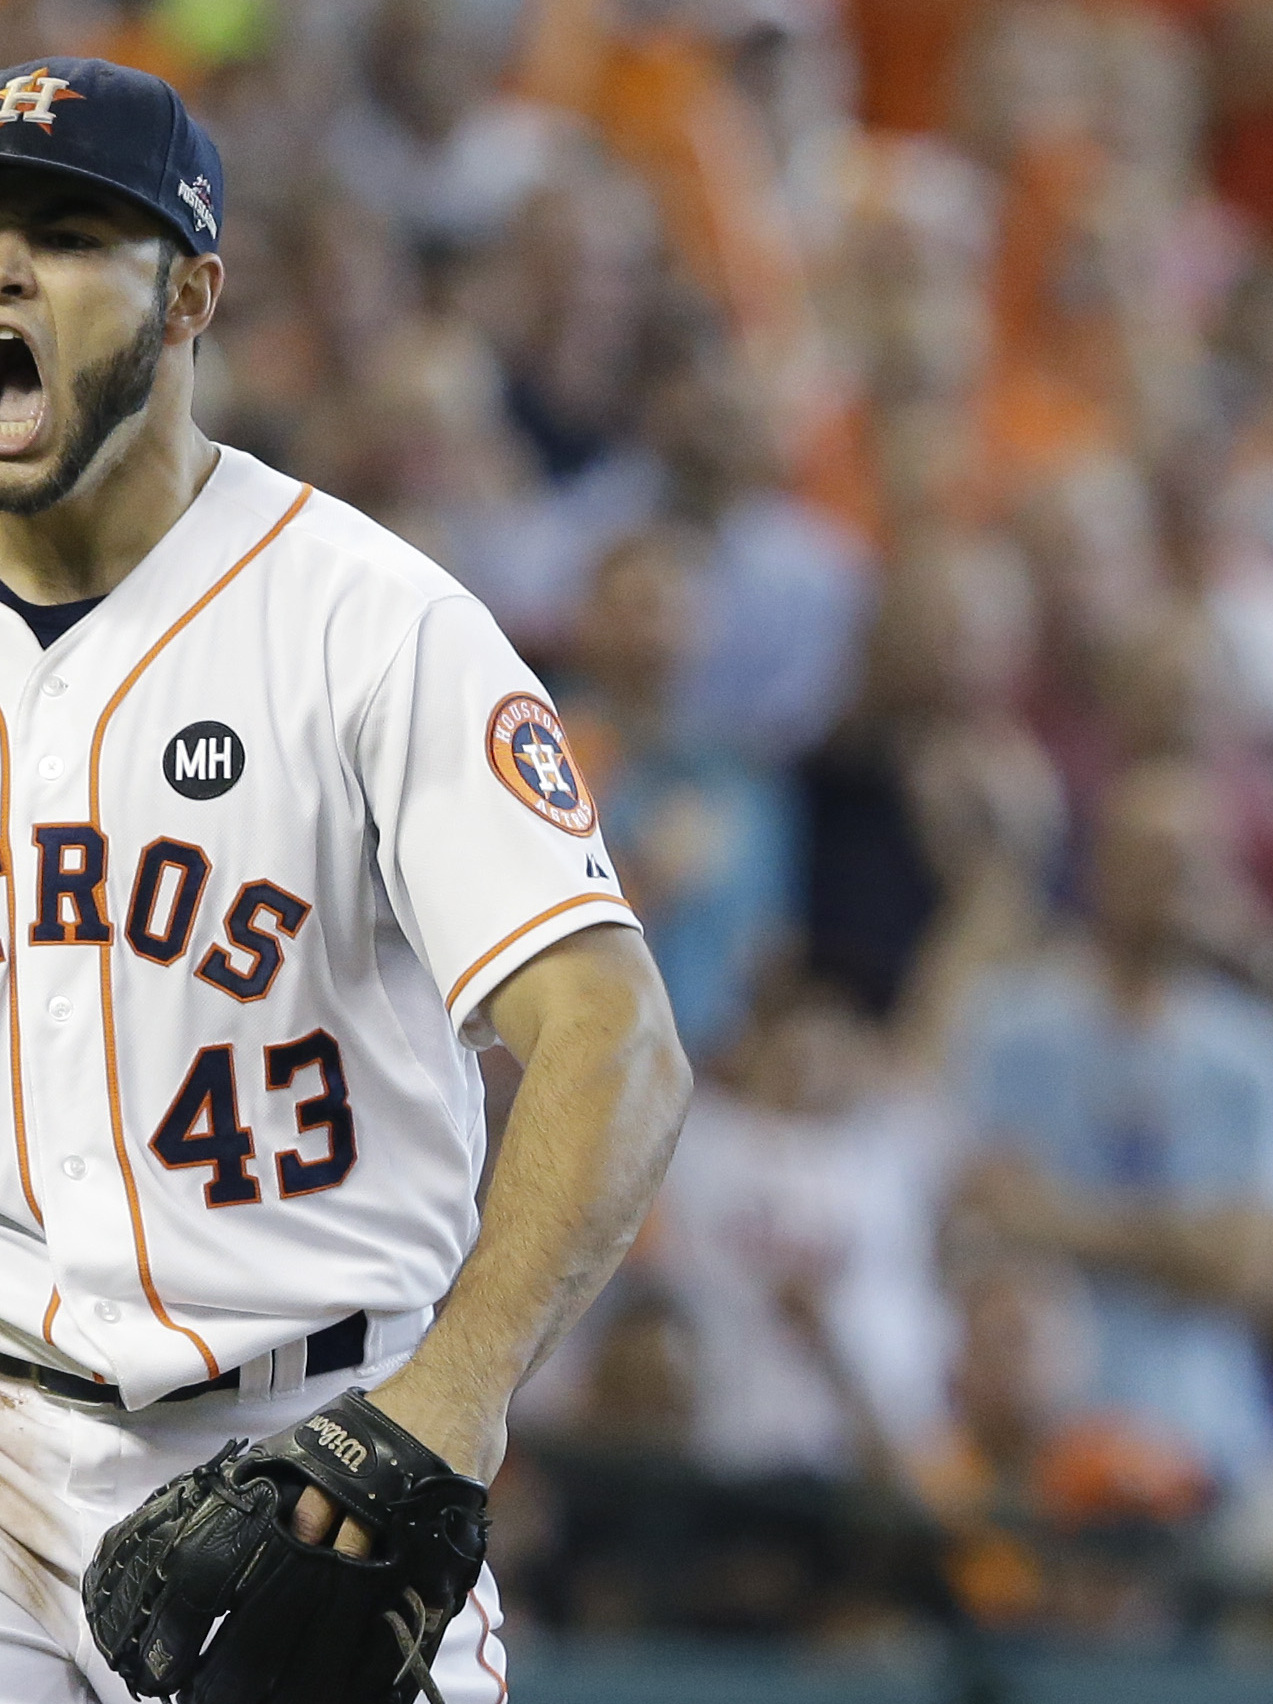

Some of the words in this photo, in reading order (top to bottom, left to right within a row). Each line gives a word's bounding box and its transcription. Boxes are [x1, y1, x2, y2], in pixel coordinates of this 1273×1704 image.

[494, 701, 564, 744] HOUSTON
[174, 736, 233, 781] MH
[521, 743, 572, 792] H
[534, 799, 593, 829] ASTROS
[148, 1028, 359, 1209] 43
[305, 1415, 368, 1472] Wilson
